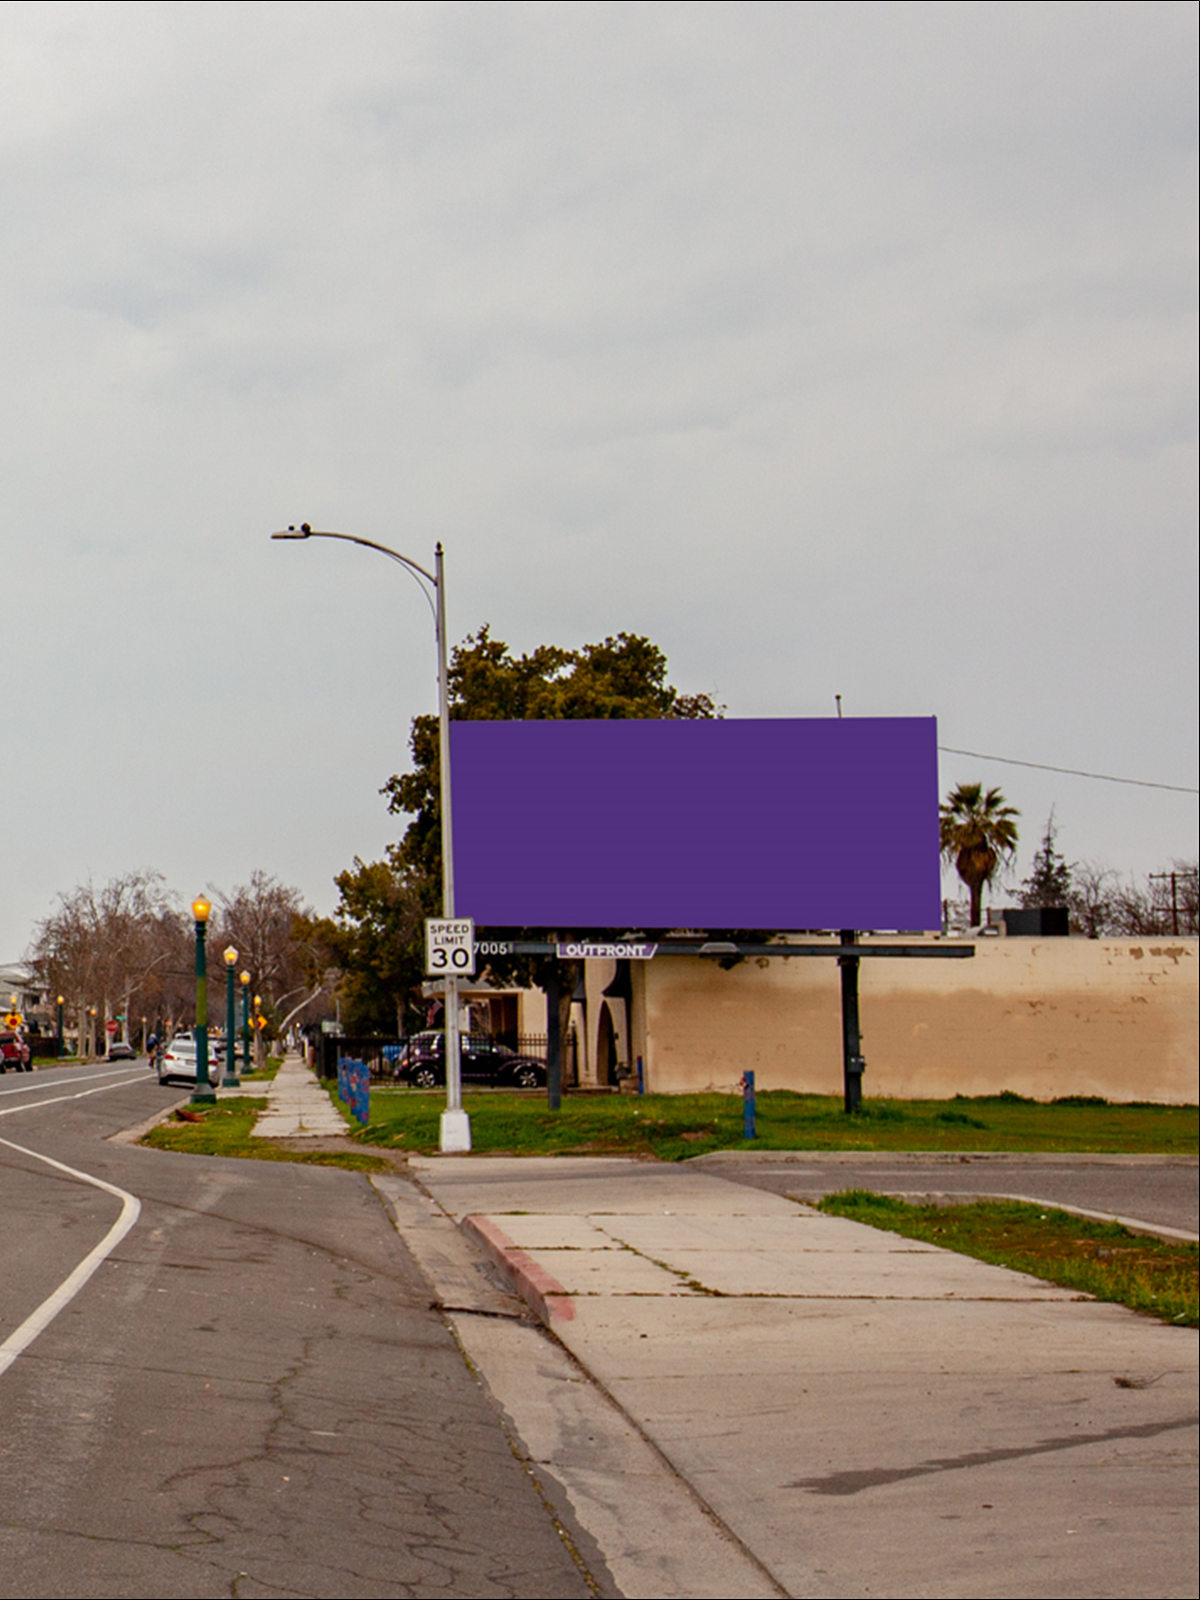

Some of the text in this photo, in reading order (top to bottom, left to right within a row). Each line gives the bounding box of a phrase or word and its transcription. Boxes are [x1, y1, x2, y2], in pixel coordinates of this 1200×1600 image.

[430, 924, 469, 934] SPEED
[434, 936, 465, 945] LIMIT
[566, 944, 646, 956] OUTFRONT
[432, 948, 469, 968] 30
